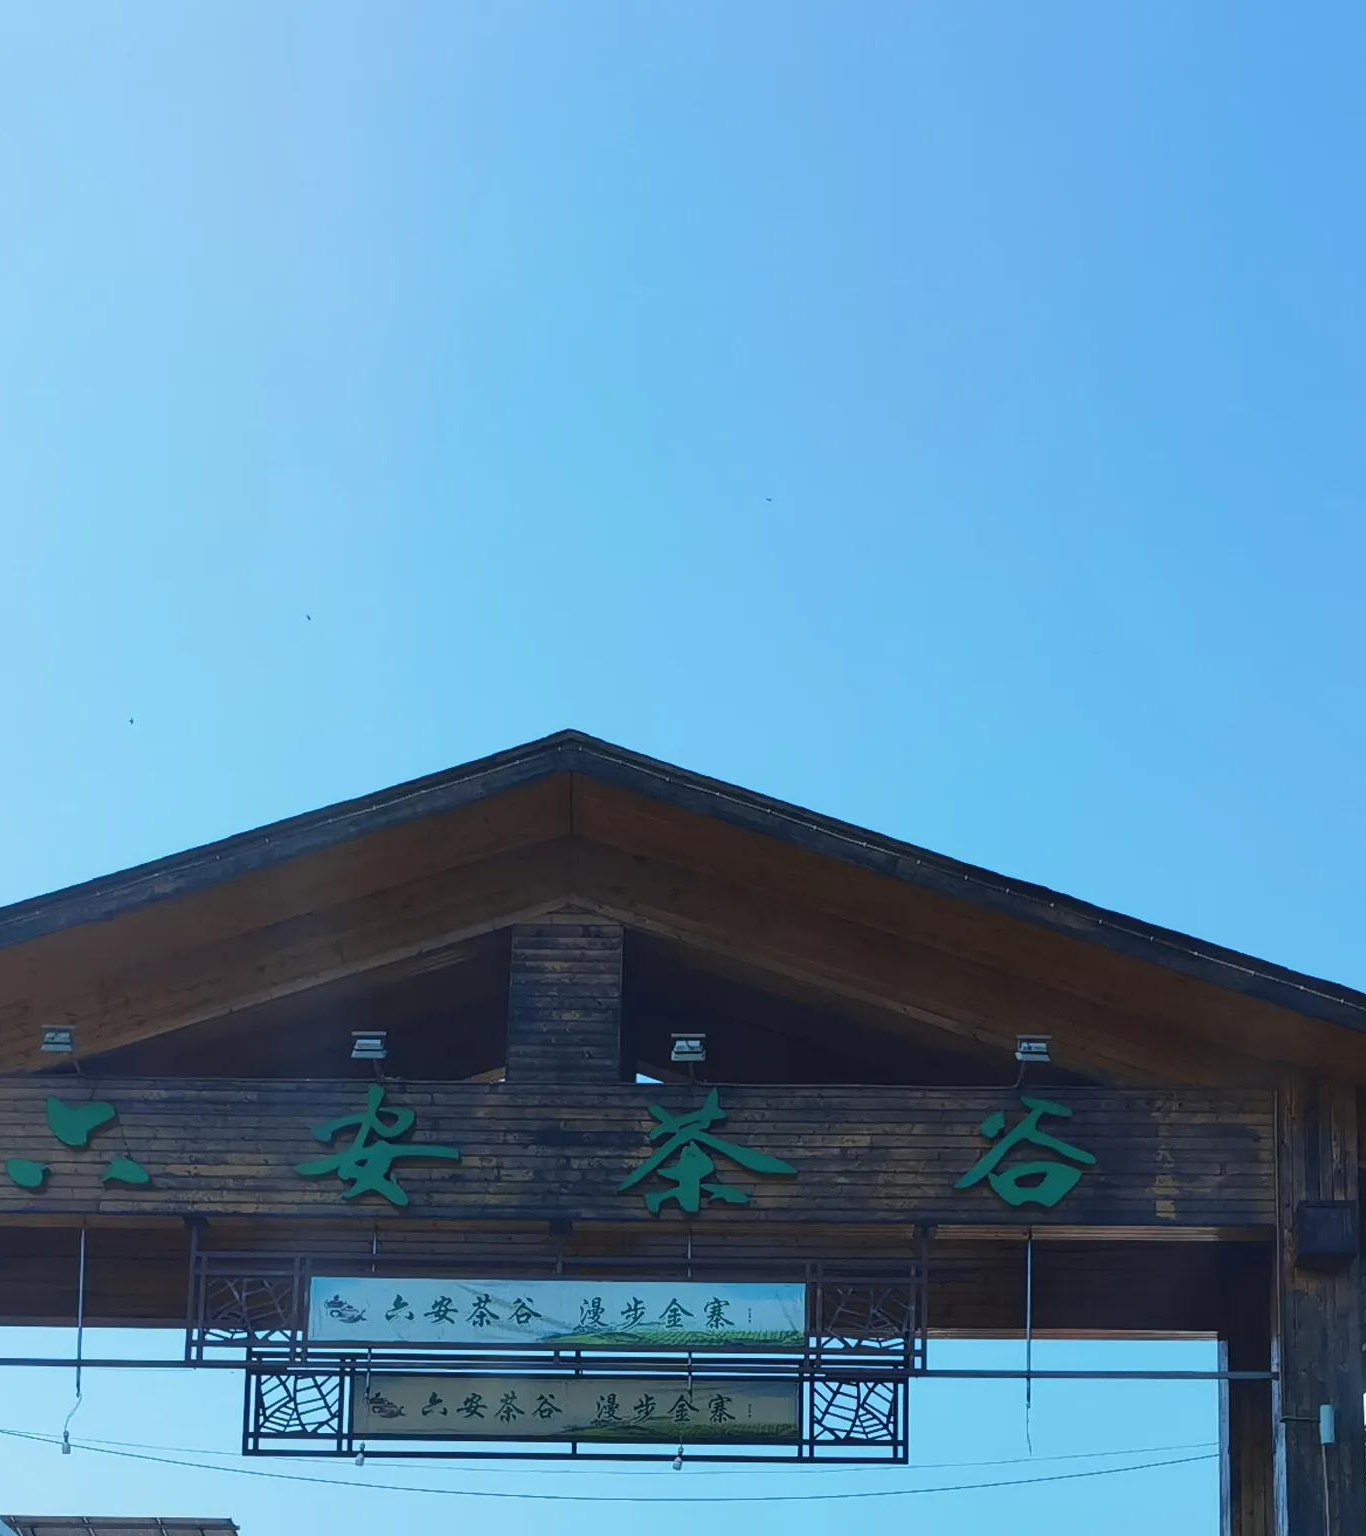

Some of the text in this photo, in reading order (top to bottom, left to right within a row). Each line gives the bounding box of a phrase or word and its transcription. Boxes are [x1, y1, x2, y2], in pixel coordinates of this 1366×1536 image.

[6, 1085, 1097, 1213] 六安茶谷
[385, 1293, 542, 1328] 六安茶谷
[579, 1296, 735, 1331] 漫步金寨
[421, 1390, 563, 1424] 六安茶谷
[596, 1393, 736, 1424] 漫步金寨
